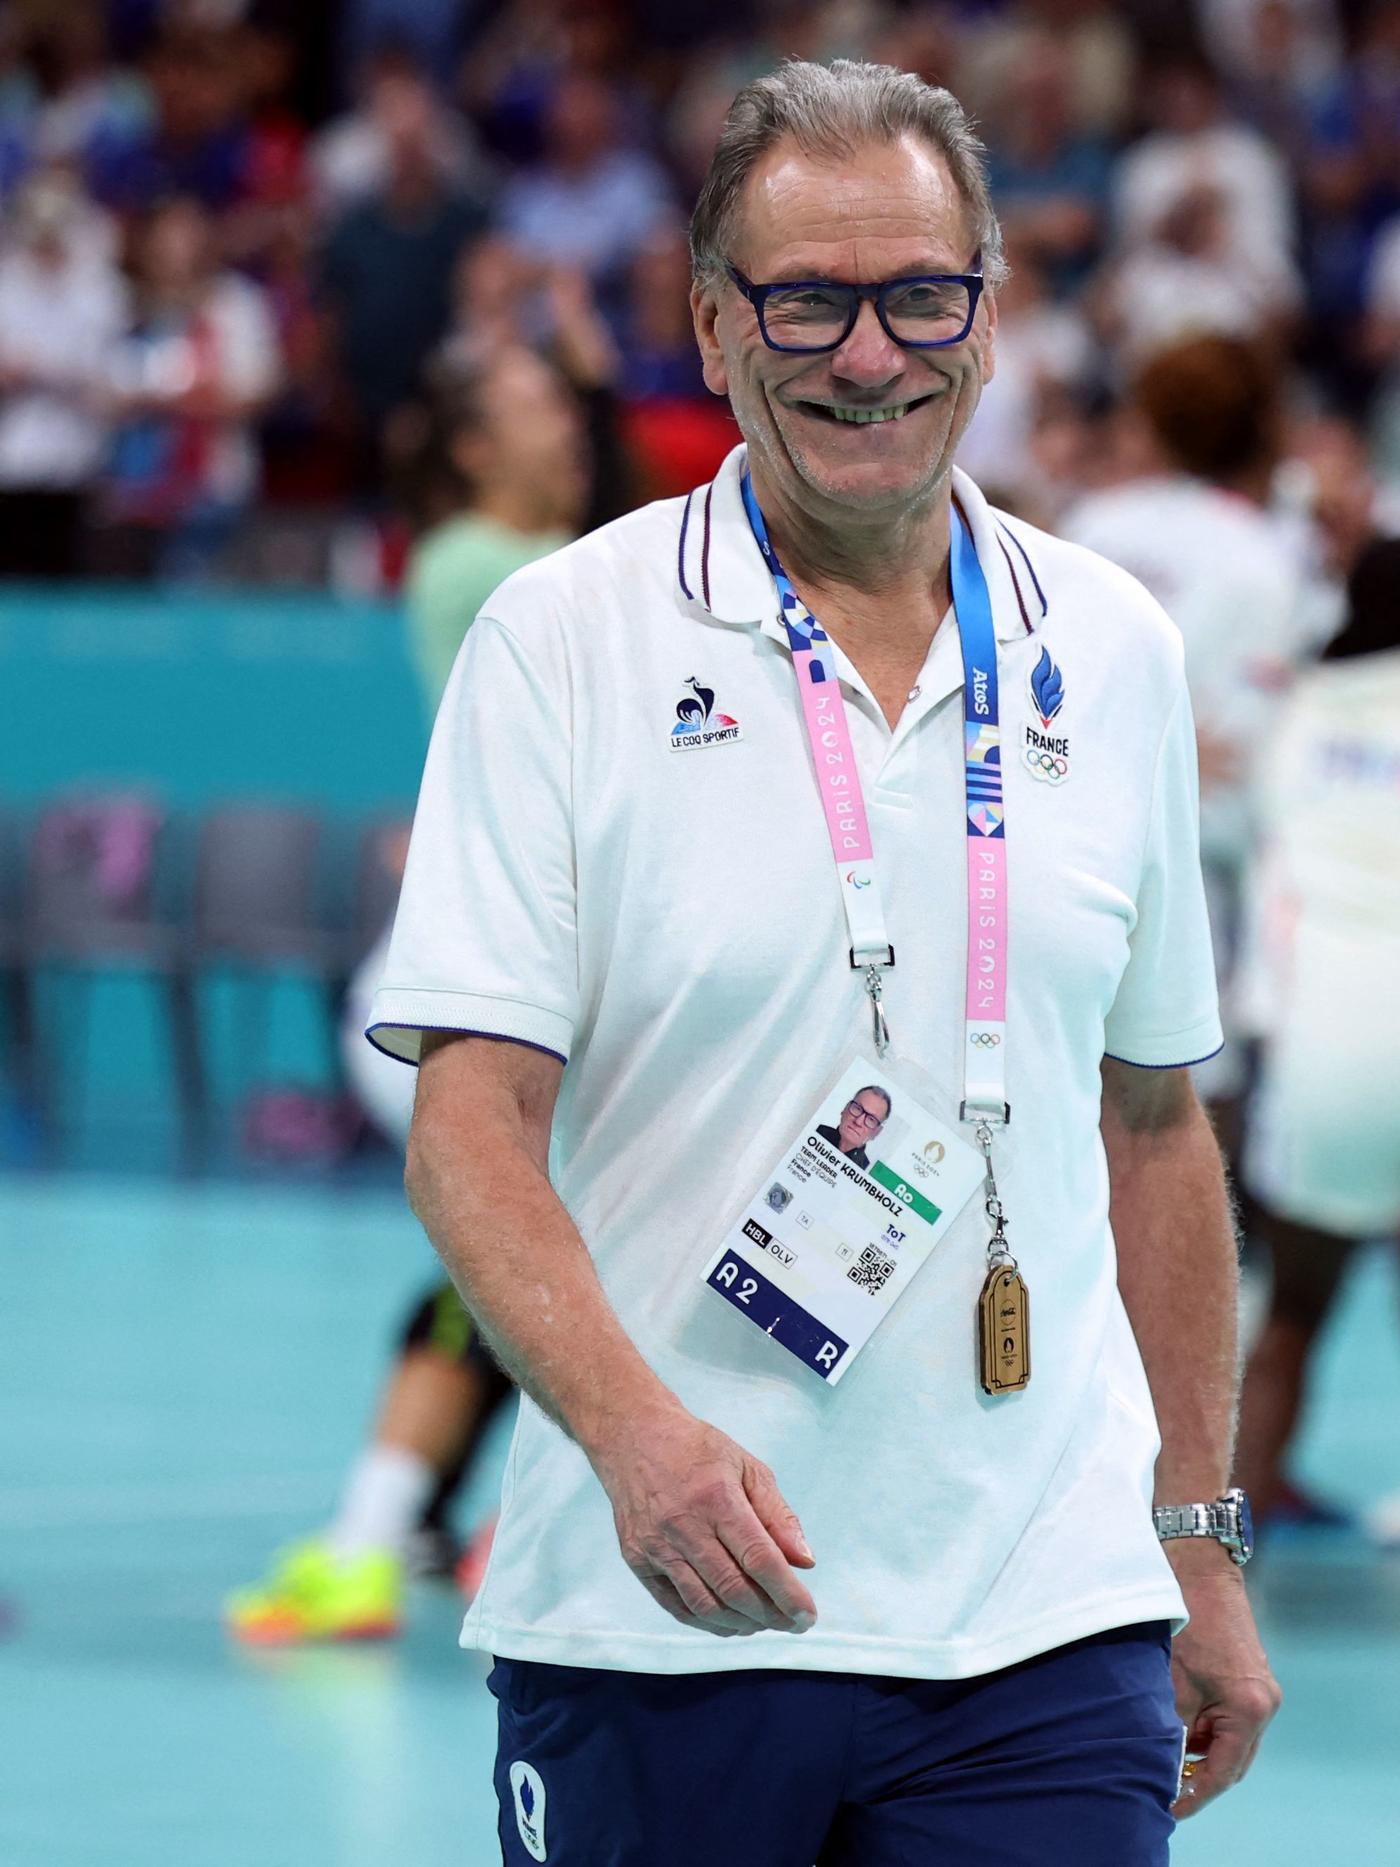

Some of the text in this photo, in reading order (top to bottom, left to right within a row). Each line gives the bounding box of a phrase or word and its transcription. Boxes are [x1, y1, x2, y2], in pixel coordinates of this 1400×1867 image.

[671, 727, 739, 748] LE COQ SPORTIF
[816, 697, 843, 765] 2024
[1026, 726, 1069, 757] FRANCE
[978, 939, 995, 1008] 2024
[787, 1164, 807, 1183] France
[791, 1159, 811, 1178] France
[800, 1146, 838, 1178] TEAM LEADER
[807, 1136, 904, 1217] Olivier KRUMBHOLZ
[893, 1183, 913, 1204] Ao
[745, 1223, 793, 1264] HBL OLV
[886, 1223, 906, 1242] ToT
[814, 1340, 839, 1369] R
